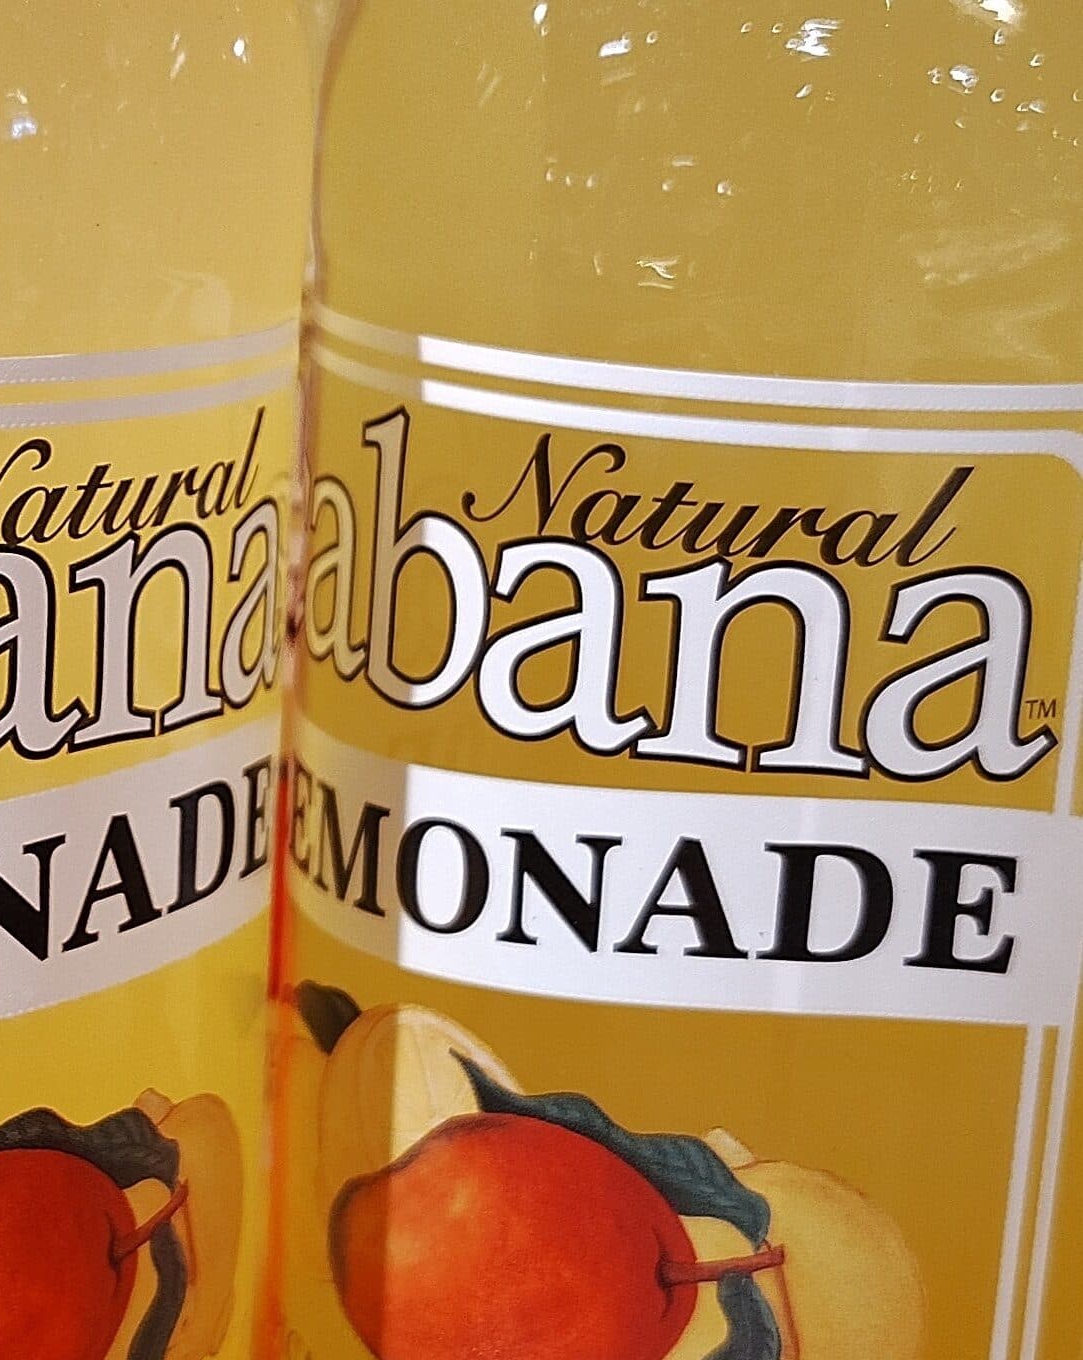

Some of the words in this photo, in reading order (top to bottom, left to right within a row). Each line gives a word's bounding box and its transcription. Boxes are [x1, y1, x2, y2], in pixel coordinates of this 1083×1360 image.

[304, 405, 1059, 782] abana
[460, 432, 975, 570] Natural
[289, 750, 1018, 976] EMONADE
